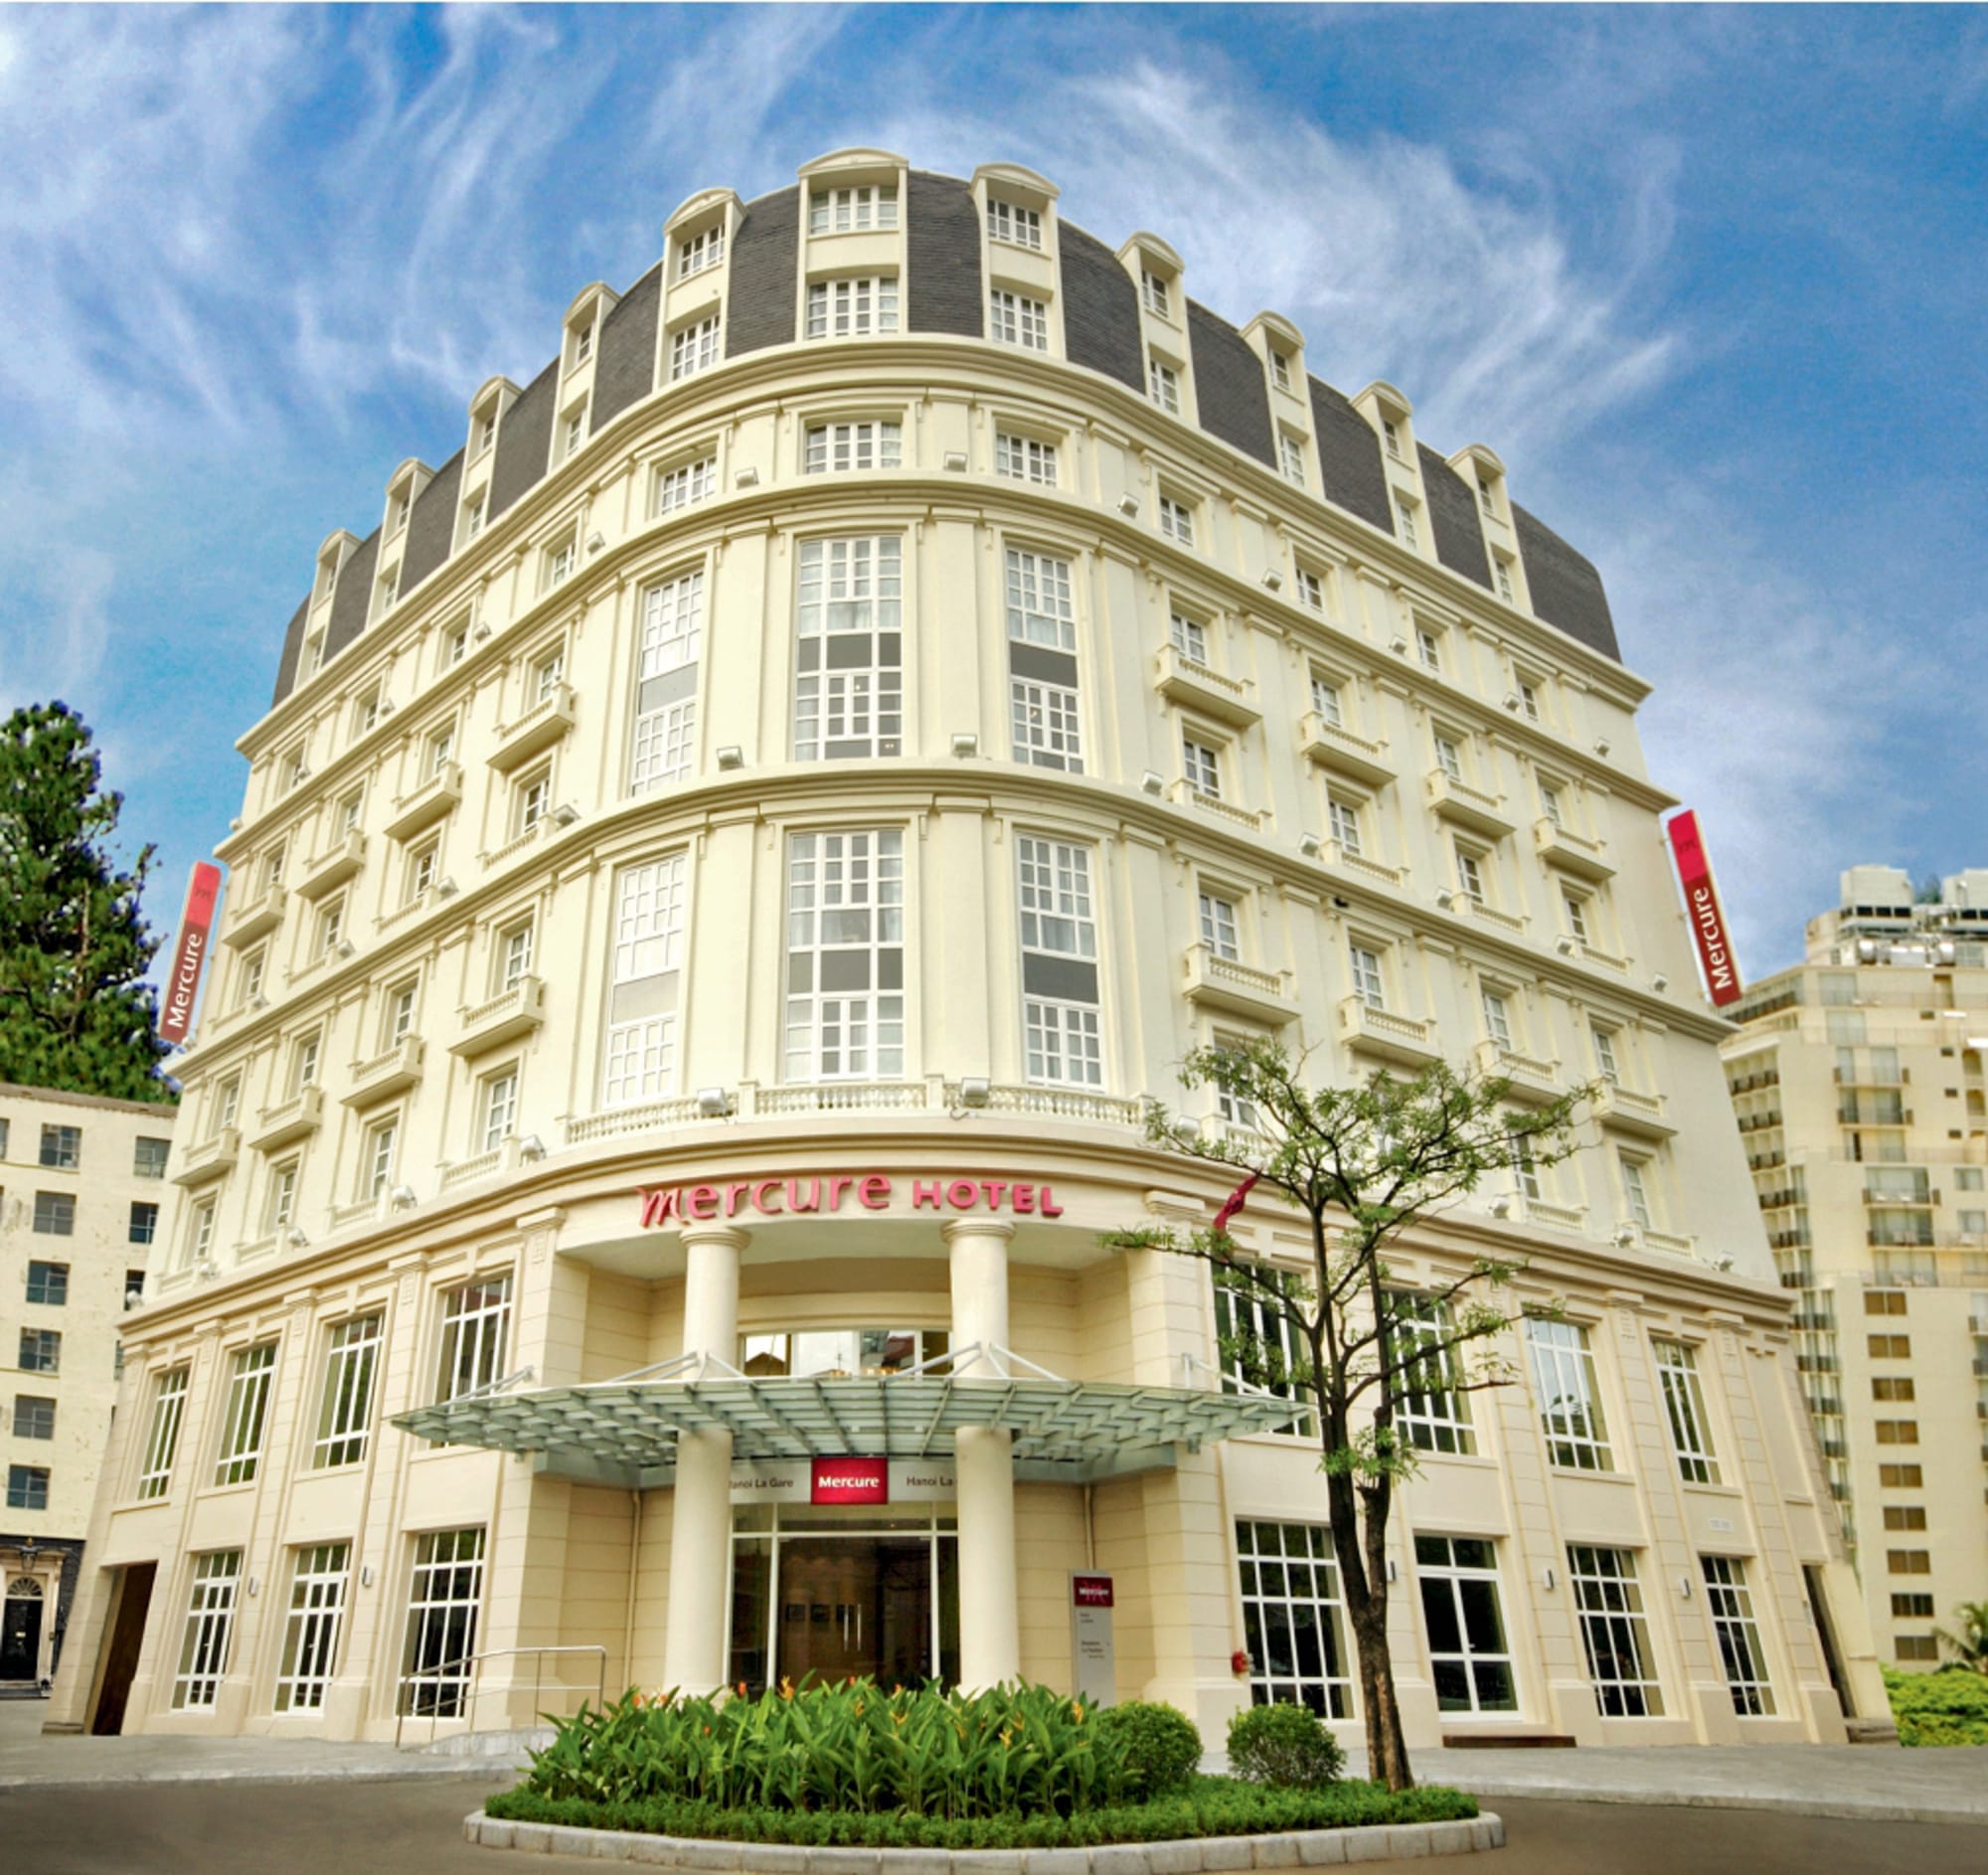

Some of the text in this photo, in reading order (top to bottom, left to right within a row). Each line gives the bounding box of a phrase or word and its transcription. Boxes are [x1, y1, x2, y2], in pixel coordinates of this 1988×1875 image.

[1694, 887, 1733, 990] Mercure
[167, 933, 203, 1028] Mercure
[911, 1179, 1064, 1217] HOTEL
[755, 1478, 767, 1488] La
[817, 1475, 880, 1488] Mercure
[906, 1475, 953, 1487] Hanoi La
